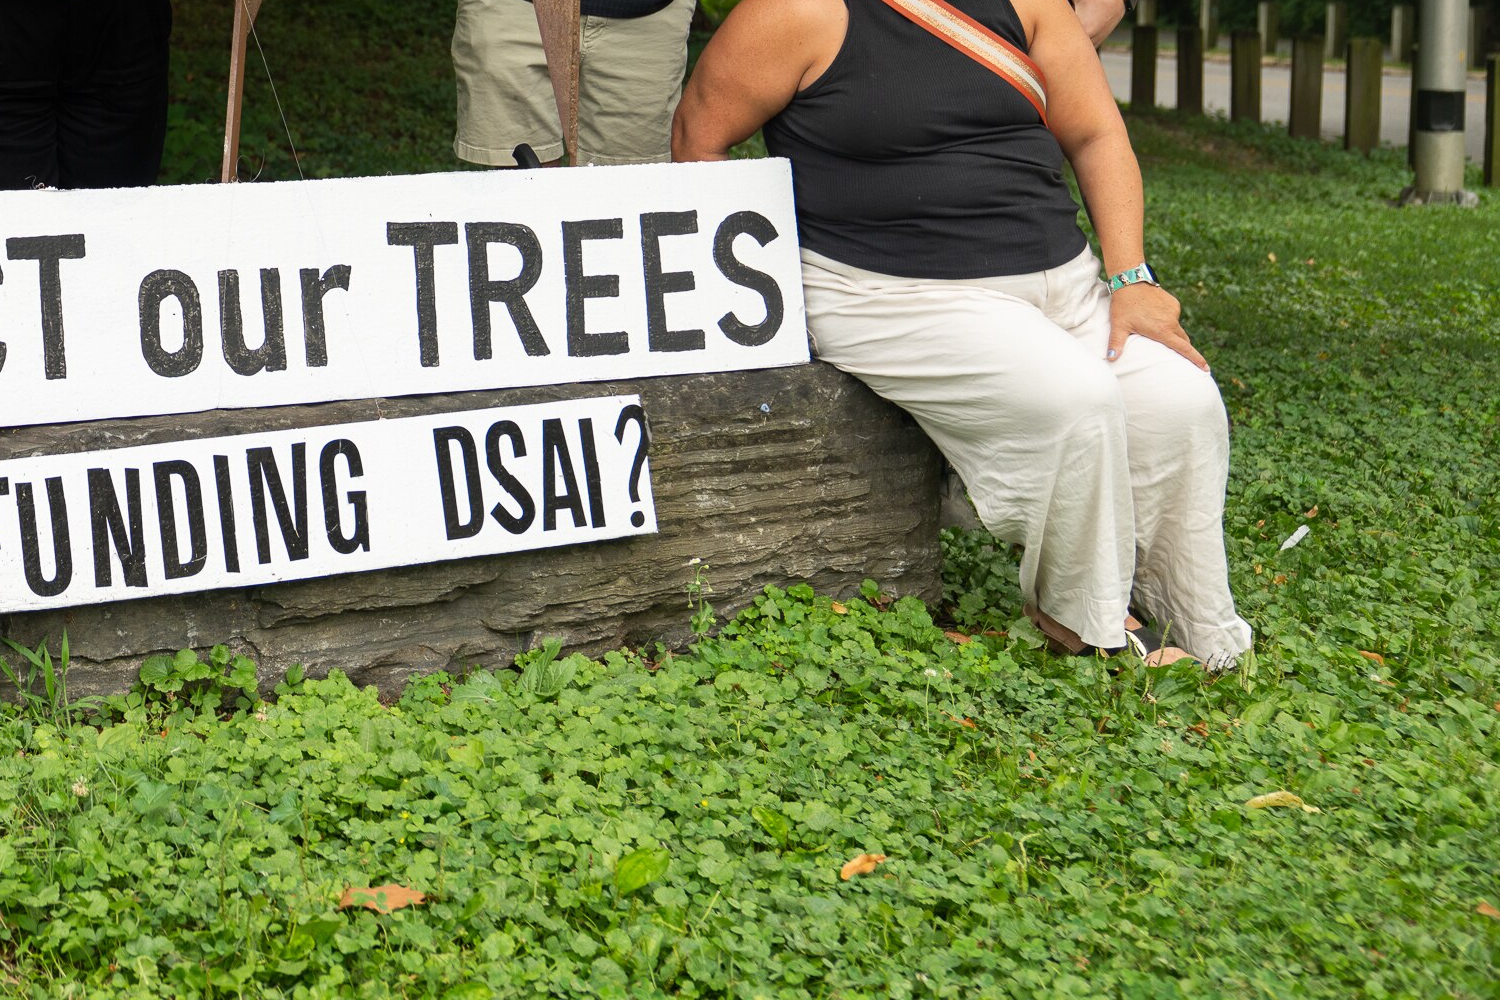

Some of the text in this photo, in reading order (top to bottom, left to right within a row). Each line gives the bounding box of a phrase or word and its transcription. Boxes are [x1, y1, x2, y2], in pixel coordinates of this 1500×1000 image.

[138, 264, 352, 378] our
[386, 210, 784, 368] TREES
[433, 404, 651, 541] DSAI?
